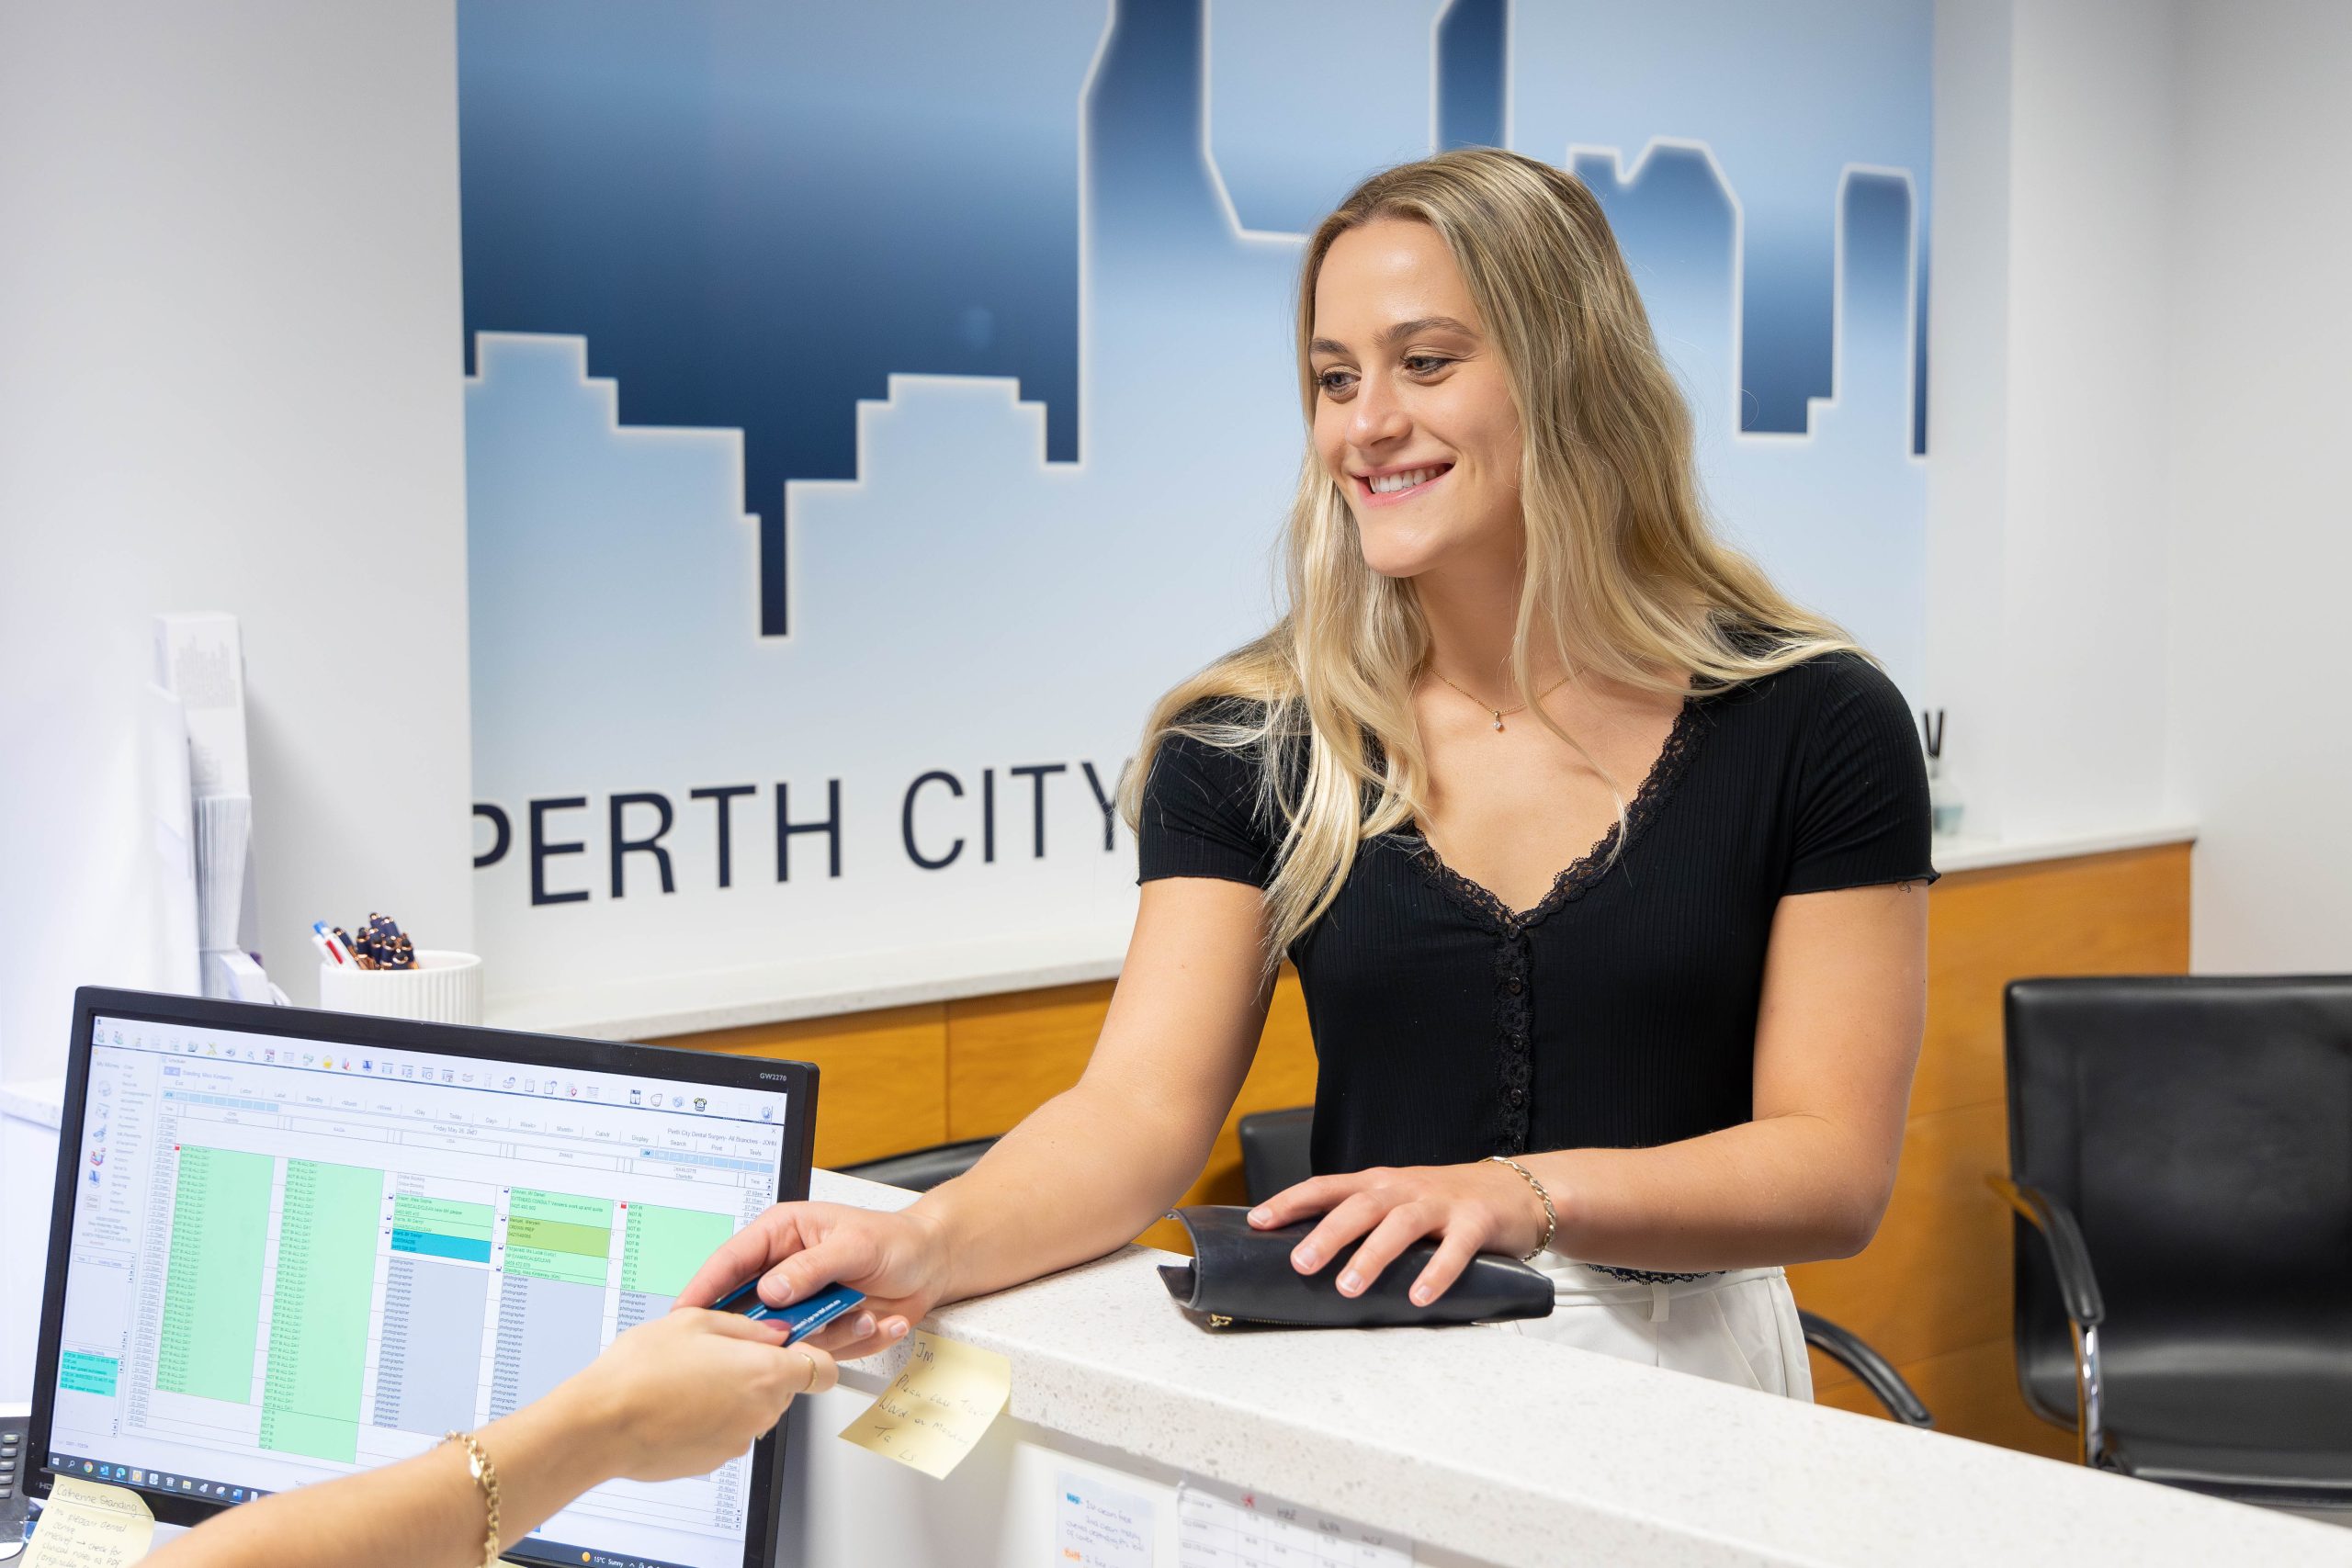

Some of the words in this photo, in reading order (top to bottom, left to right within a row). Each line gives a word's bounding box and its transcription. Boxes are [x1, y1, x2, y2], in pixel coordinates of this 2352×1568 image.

[901, 759, 1130, 871] CITY
[760, 1072, 787, 1082] GW2270
[100, 1495, 139, 1517] Standing
[608, 1559, 624, 1568] Sunny
